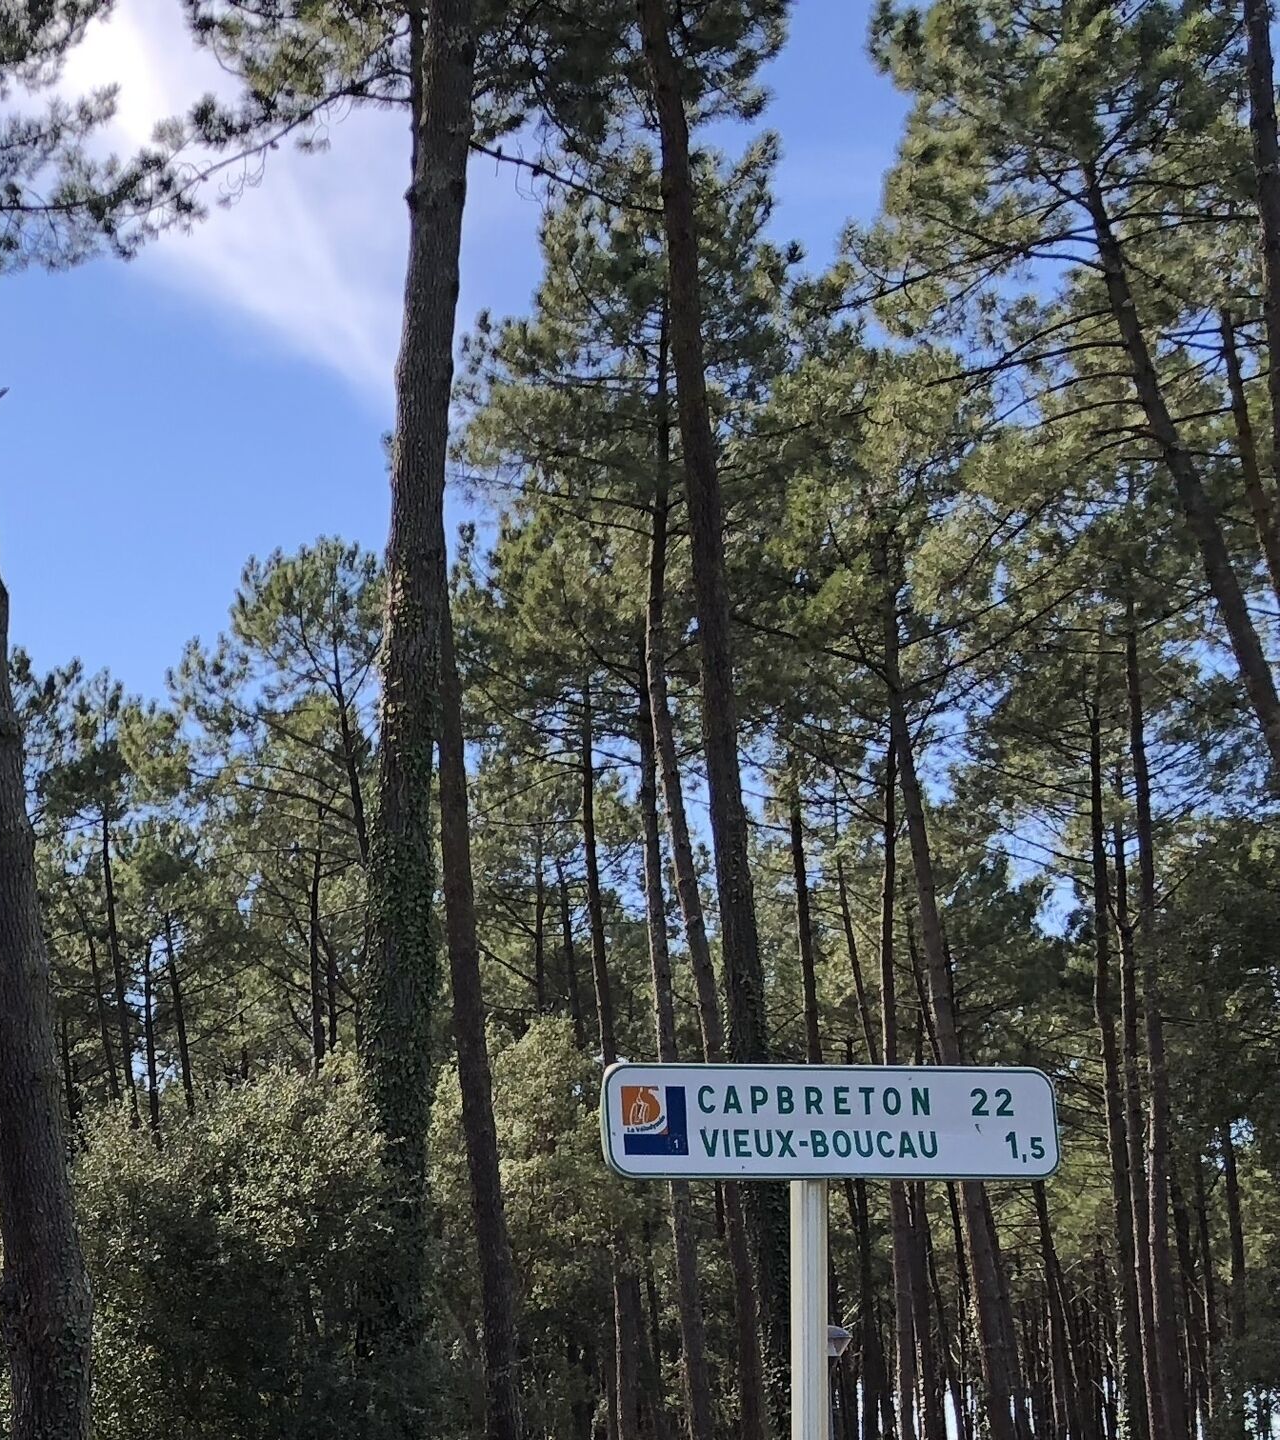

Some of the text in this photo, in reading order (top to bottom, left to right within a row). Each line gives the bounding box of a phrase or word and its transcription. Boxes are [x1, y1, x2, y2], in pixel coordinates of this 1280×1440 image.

[697, 1084, 1015, 1117] CAPBRETON 22
[673, 1138, 679, 1149] 1
[699, 1126, 1046, 1164] VIEUX-BOUCAU 1,5
